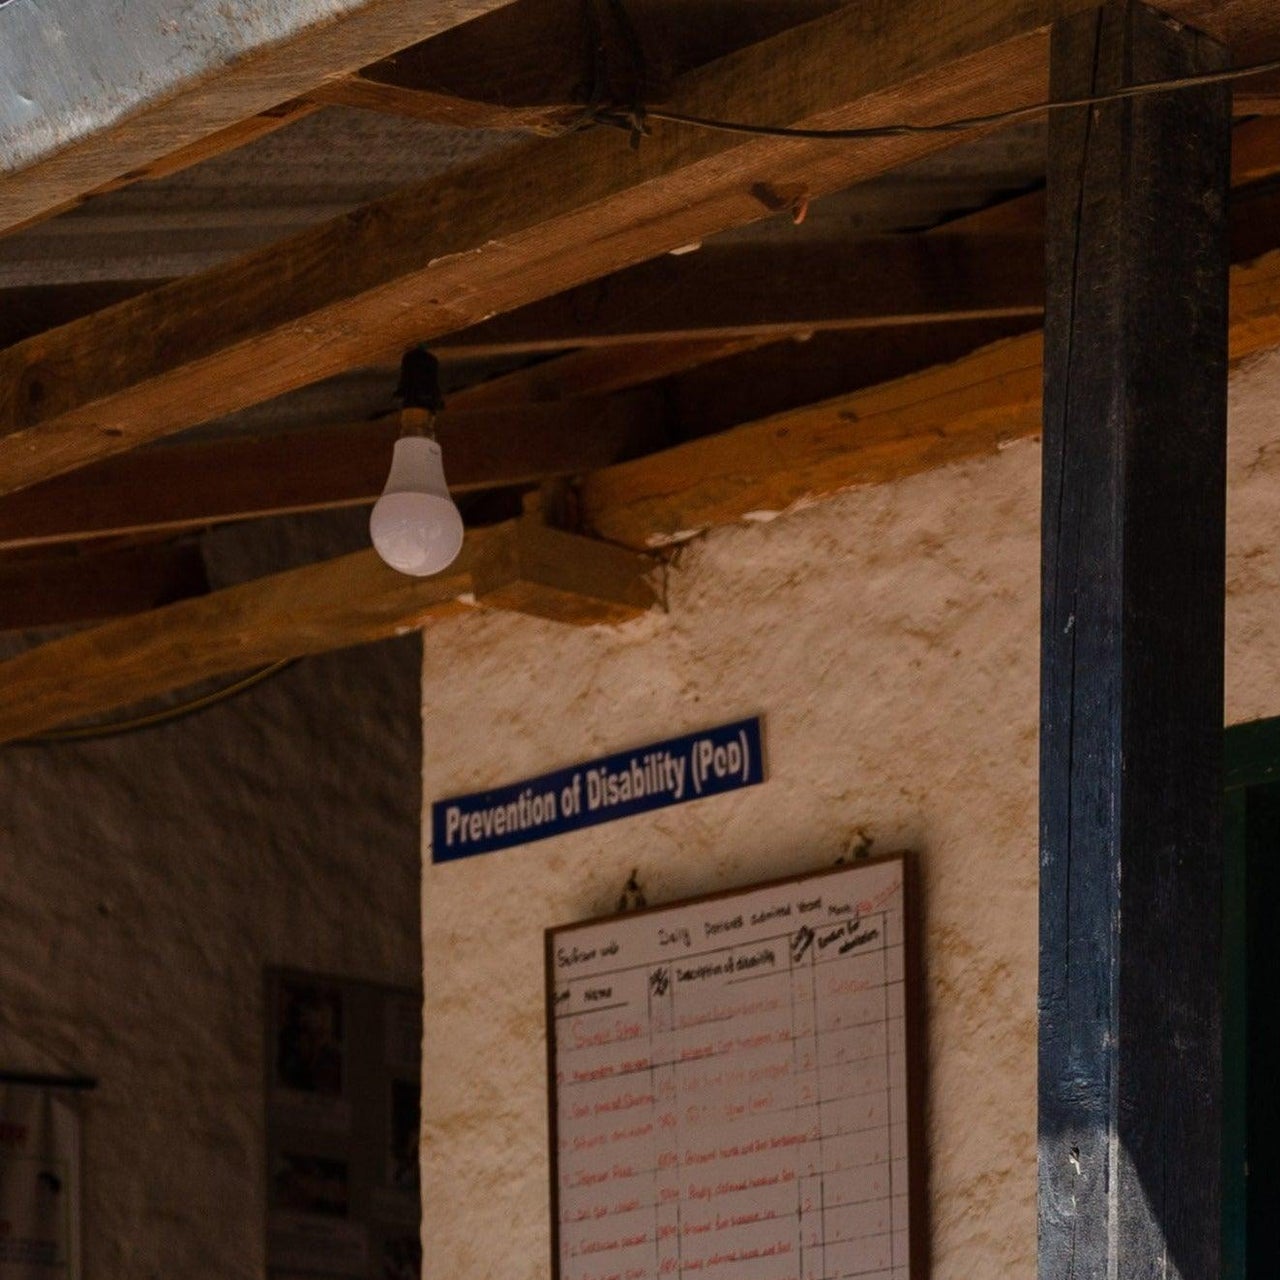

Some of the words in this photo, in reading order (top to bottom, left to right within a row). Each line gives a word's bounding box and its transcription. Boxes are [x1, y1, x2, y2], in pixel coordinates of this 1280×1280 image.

[445, 787, 557, 848] Prevention
[560, 773, 582, 817] of
[586, 752, 686, 812] Disability
